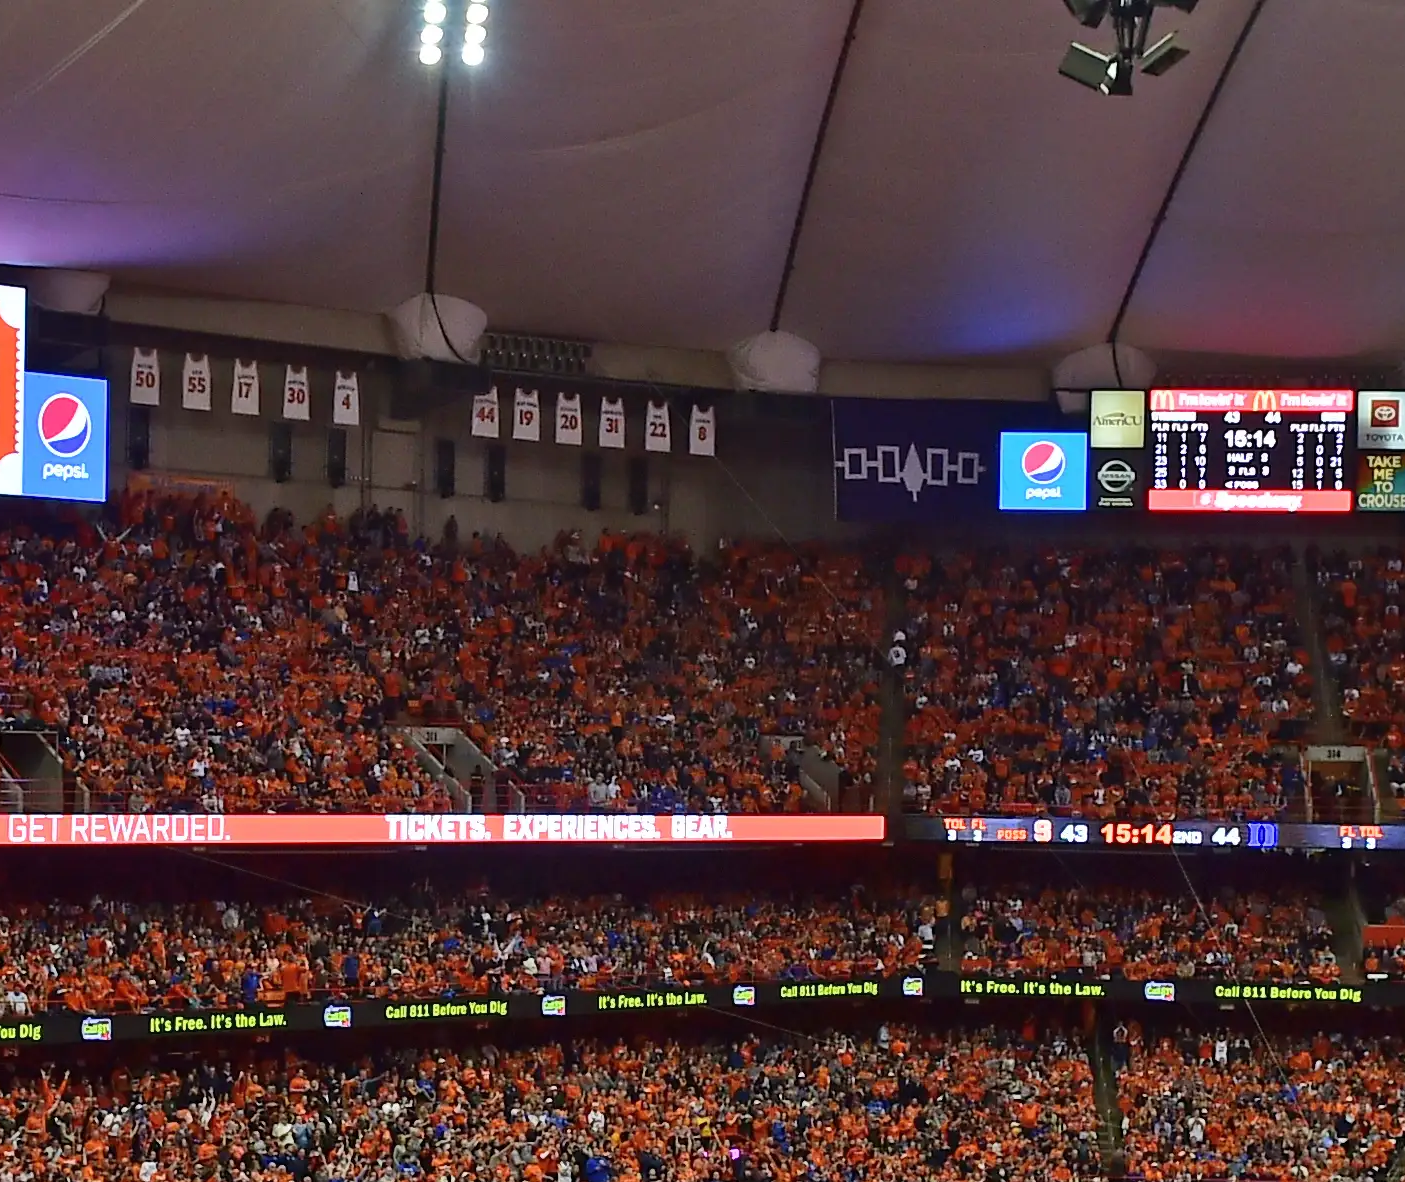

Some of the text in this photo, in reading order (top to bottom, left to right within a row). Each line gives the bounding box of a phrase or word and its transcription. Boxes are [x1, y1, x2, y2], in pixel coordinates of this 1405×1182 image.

[135, 370, 155, 388] 50
[187, 376, 206, 394] 55
[238, 382, 252, 399] 17
[287, 387, 305, 404] 30
[341, 394, 351, 410] 4
[475, 406, 495, 423] 44
[519, 409, 533, 425] 19
[560, 414, 578, 430] 20
[1093, 416, 1142, 426] AmeriCU
[605, 418, 619, 434] 31
[649, 422, 667, 438] 22
[698, 426, 707, 441] 8
[1157, 433, 1186, 442] 11 1
[1224, 430, 1276, 448] 15:14
[1317, 433, 1323, 442] 1
[1364, 433, 1404, 442] TOYOTA
[1155, 444, 1167, 454] 21
[1180, 456, 1206, 466] 1 10
[1226, 452, 1254, 463] HALF
[1330, 456, 1342, 466] 21
[1366, 455, 1402, 468] TAKE
[1180, 467, 1186, 477] 1
[1292, 467, 1304, 477] 12
[1373, 468, 1394, 481] ME
[1316, 479, 1322, 489] 1
[1374, 481, 1393, 492] TO
[1025, 486, 1062, 500] pepsi
[7, 814, 62, 843] GET
[71, 813, 231, 842] REWARDED.
[385, 815, 733, 840] TICKETS. EXPERIENCES. GEAR.
[943, 818, 987, 830] TOL FL
[1033, 819, 1089, 842] S 43
[1339, 825, 1356, 837] FL
[997, 829, 1026, 840] POSS
[1100, 822, 1202, 845] 15:14 2ND
[1211, 826, 1240, 846] 44
[960, 980, 1105, 996] It's Free. It's the Law.
[1215, 985, 1361, 1002] Call 811 Before You Dig
[598, 991, 707, 1010] It's Free. It's the Law.
[385, 1000, 508, 1019] Call 811 Before You Dig
[150, 1012, 287, 1032] It's Free. It's the Law.
[18, 1024, 41, 1041] Dig
